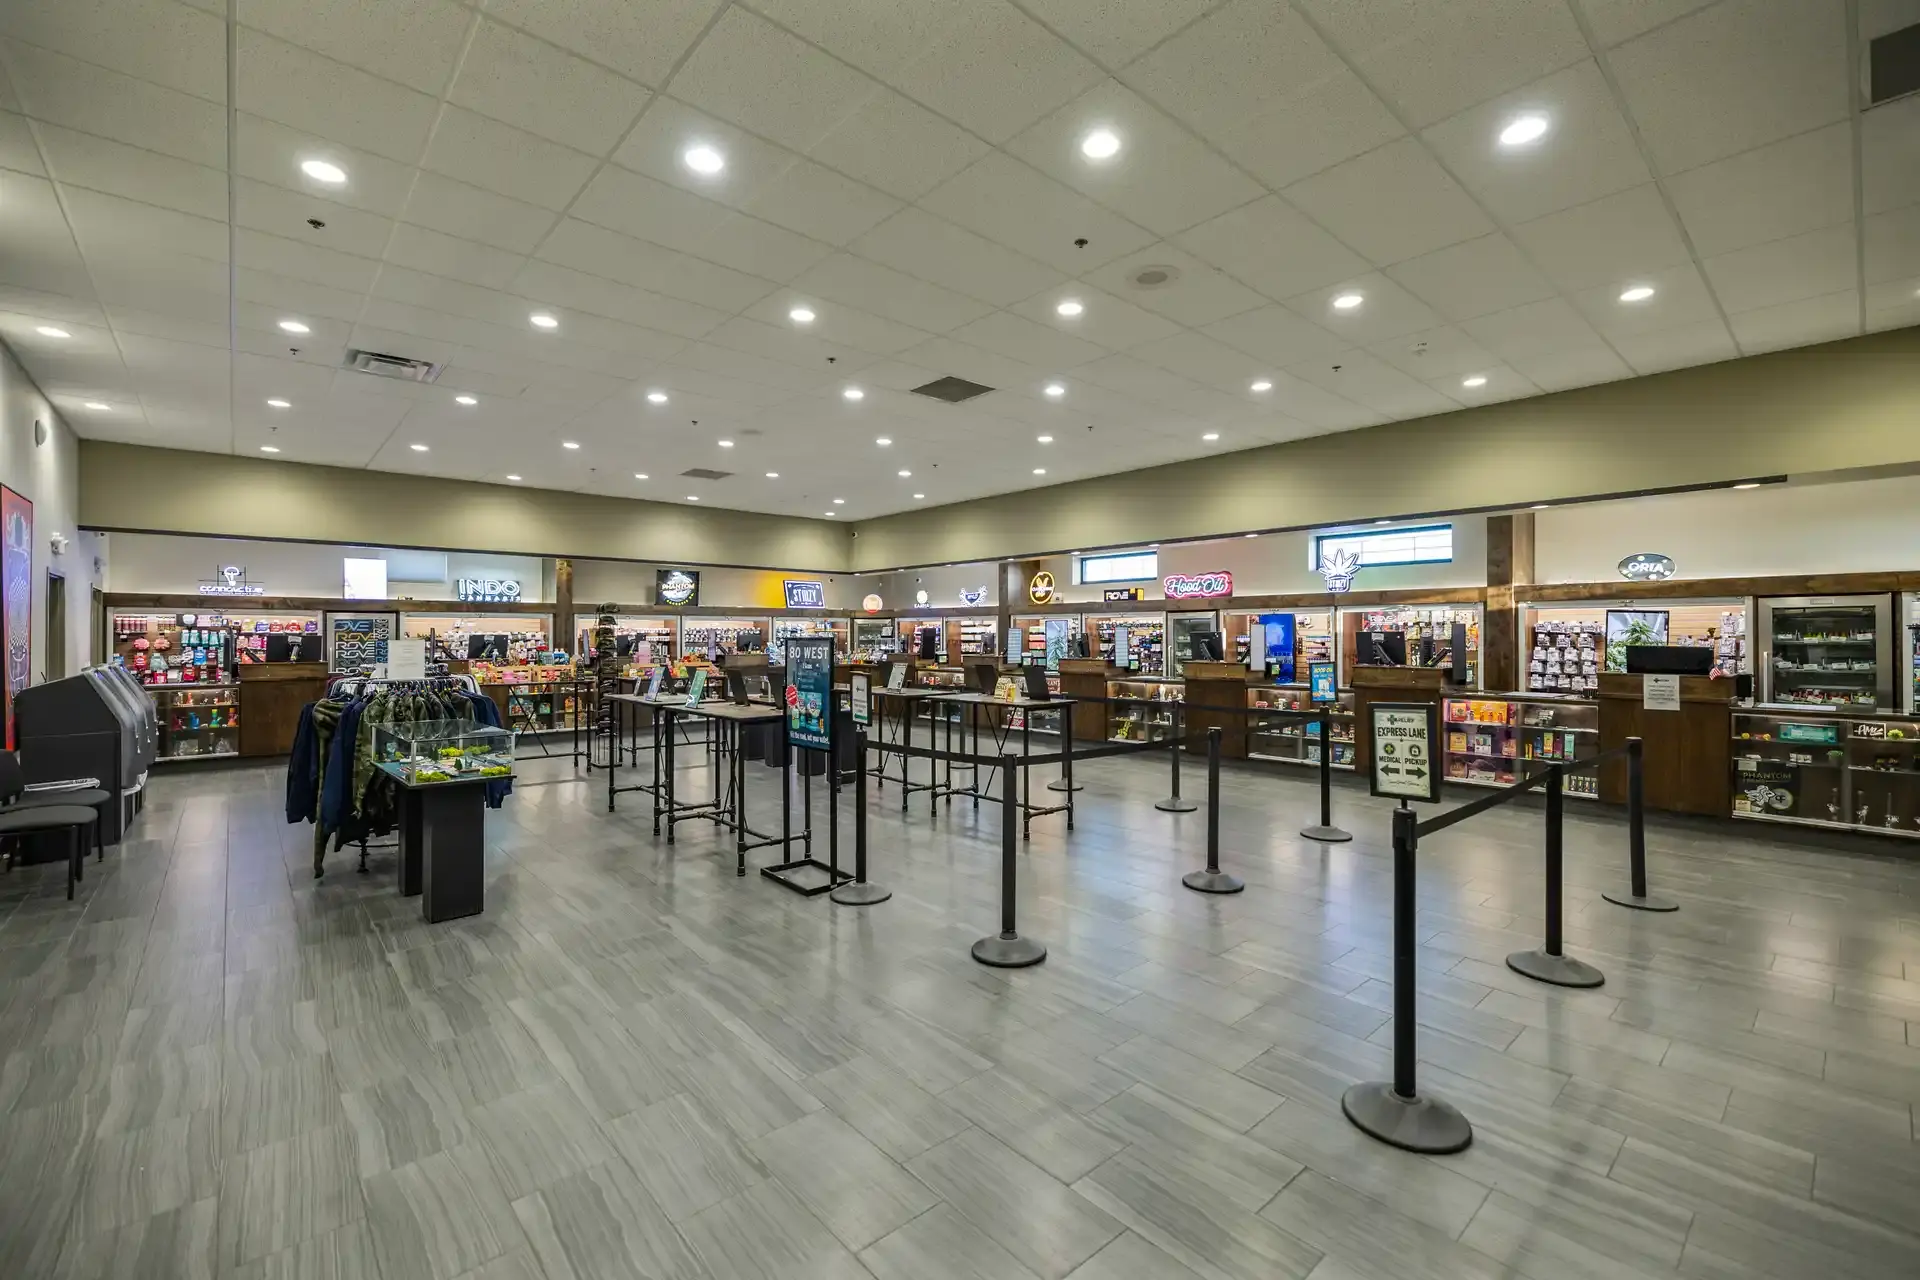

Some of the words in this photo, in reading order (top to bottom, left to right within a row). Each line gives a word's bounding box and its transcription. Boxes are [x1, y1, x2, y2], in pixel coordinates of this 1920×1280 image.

[459, 579, 520, 596] INDO
[1105, 591, 1129, 600] ROVE
[336, 650, 375, 658] ROVE
[789, 647, 801, 659] 80
[803, 647, 829, 659] WEST
[1377, 727, 1407, 737] EXPRESS
[1408, 728, 1426, 739] LANE
[1379, 756, 1401, 764] MEDICAL
[1405, 758, 1428, 766] PICKUP
[1743, 772, 1791, 780] PHANTOM
